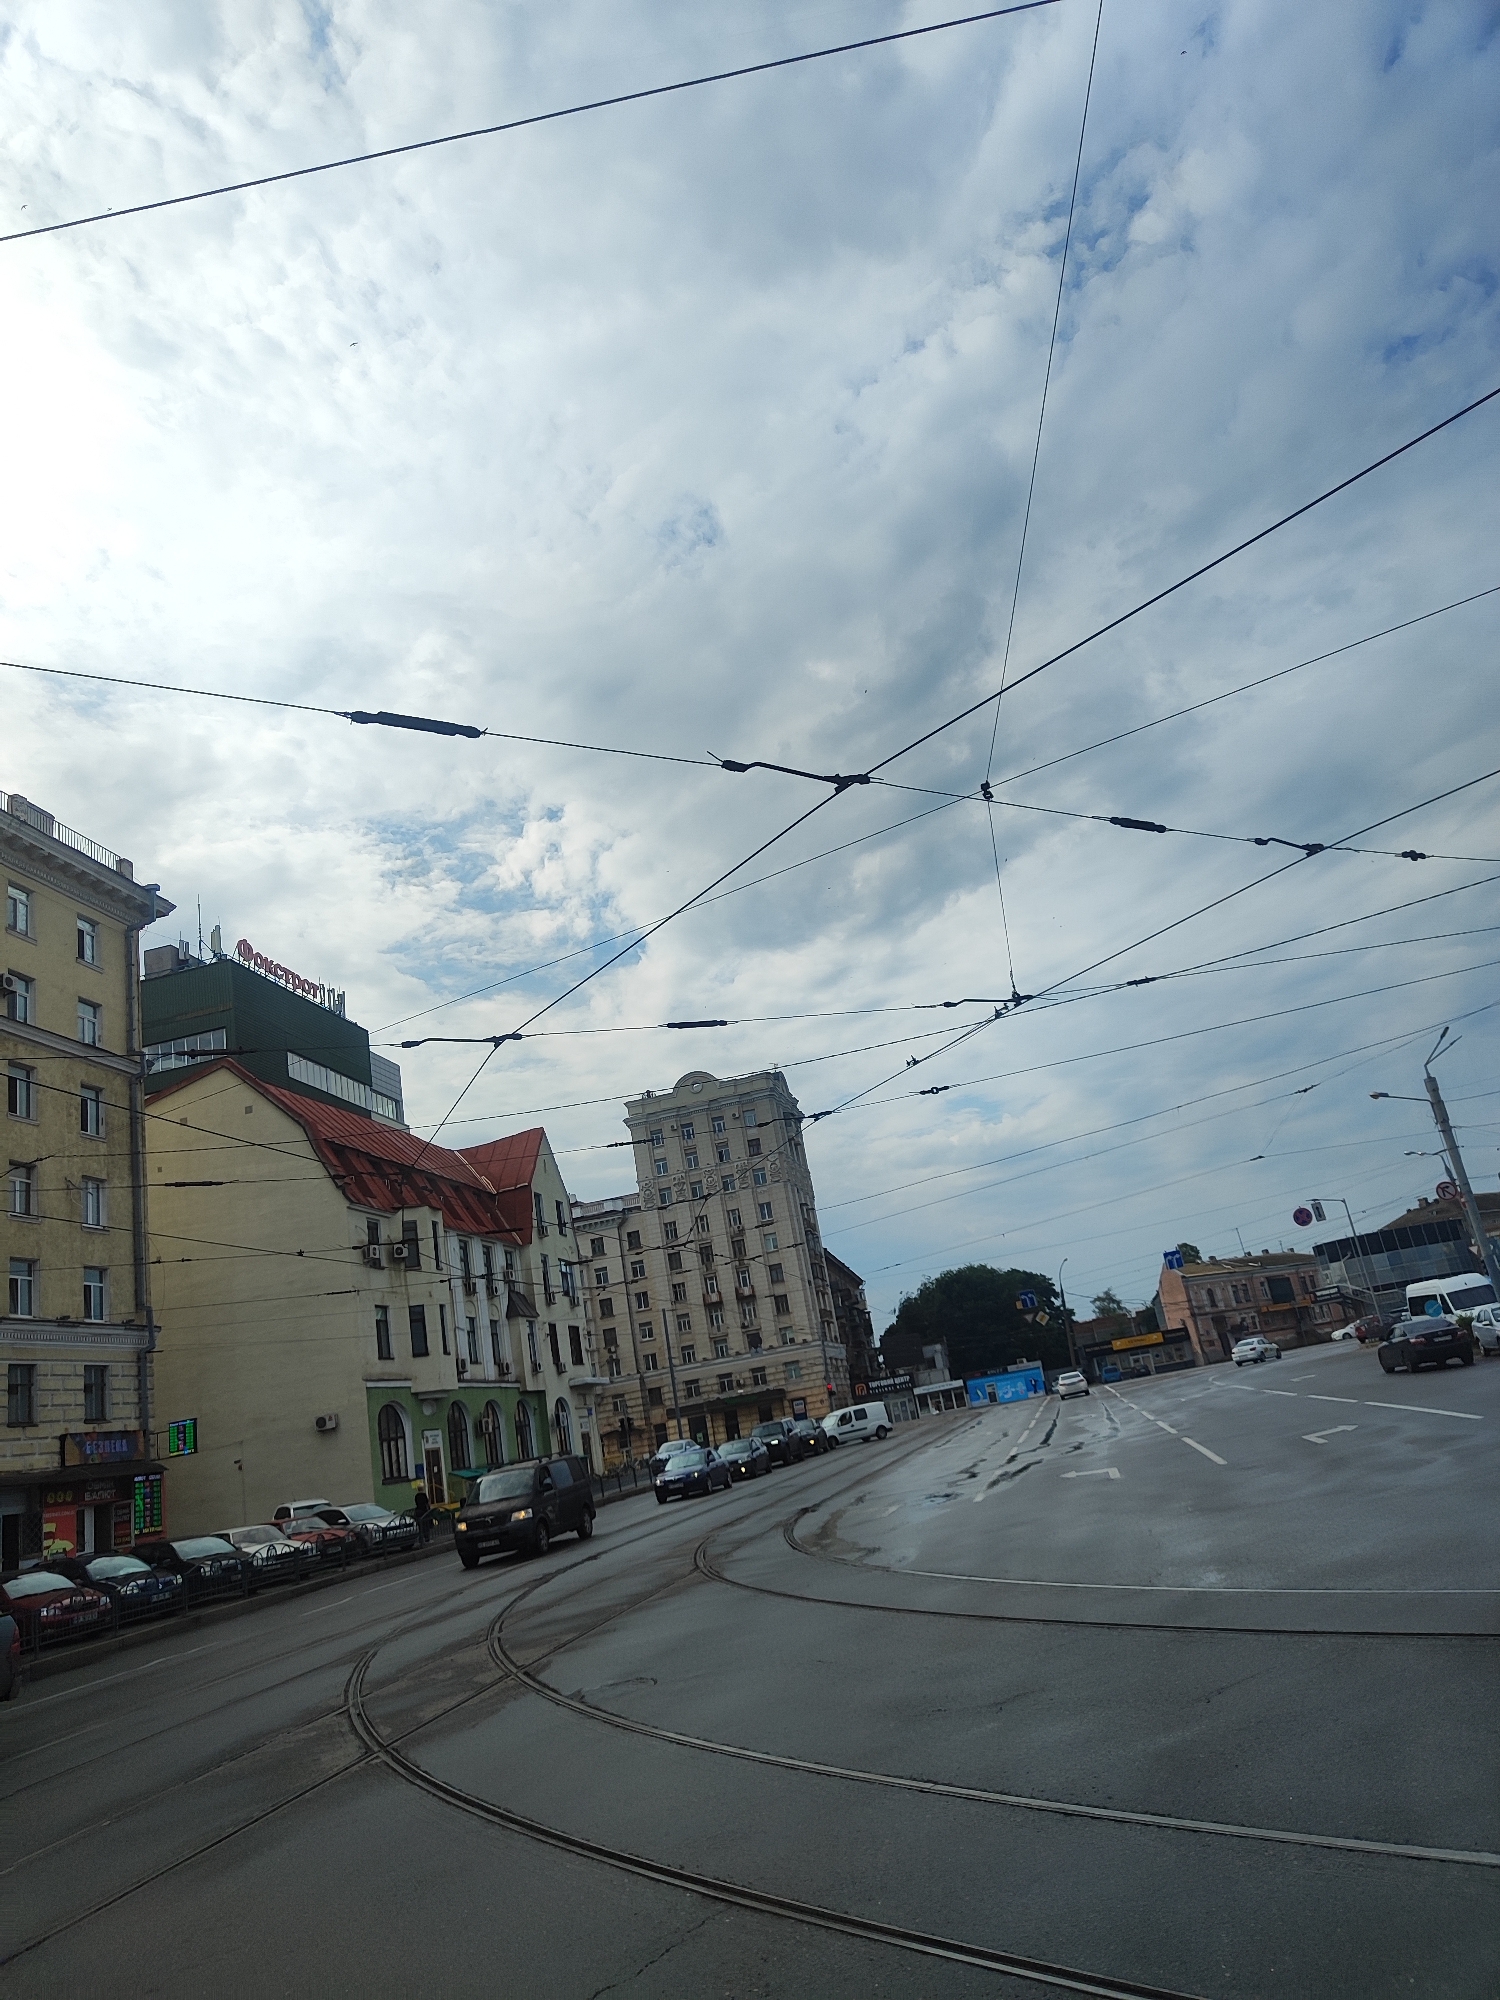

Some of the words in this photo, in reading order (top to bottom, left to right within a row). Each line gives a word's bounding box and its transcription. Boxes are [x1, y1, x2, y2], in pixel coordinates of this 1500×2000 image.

[238, 939, 319, 998] Фокстрот
[86, 1439, 127, 1454] БЕЗПЕКА
[84, 1490, 116, 1501] ВАЛЮТ
